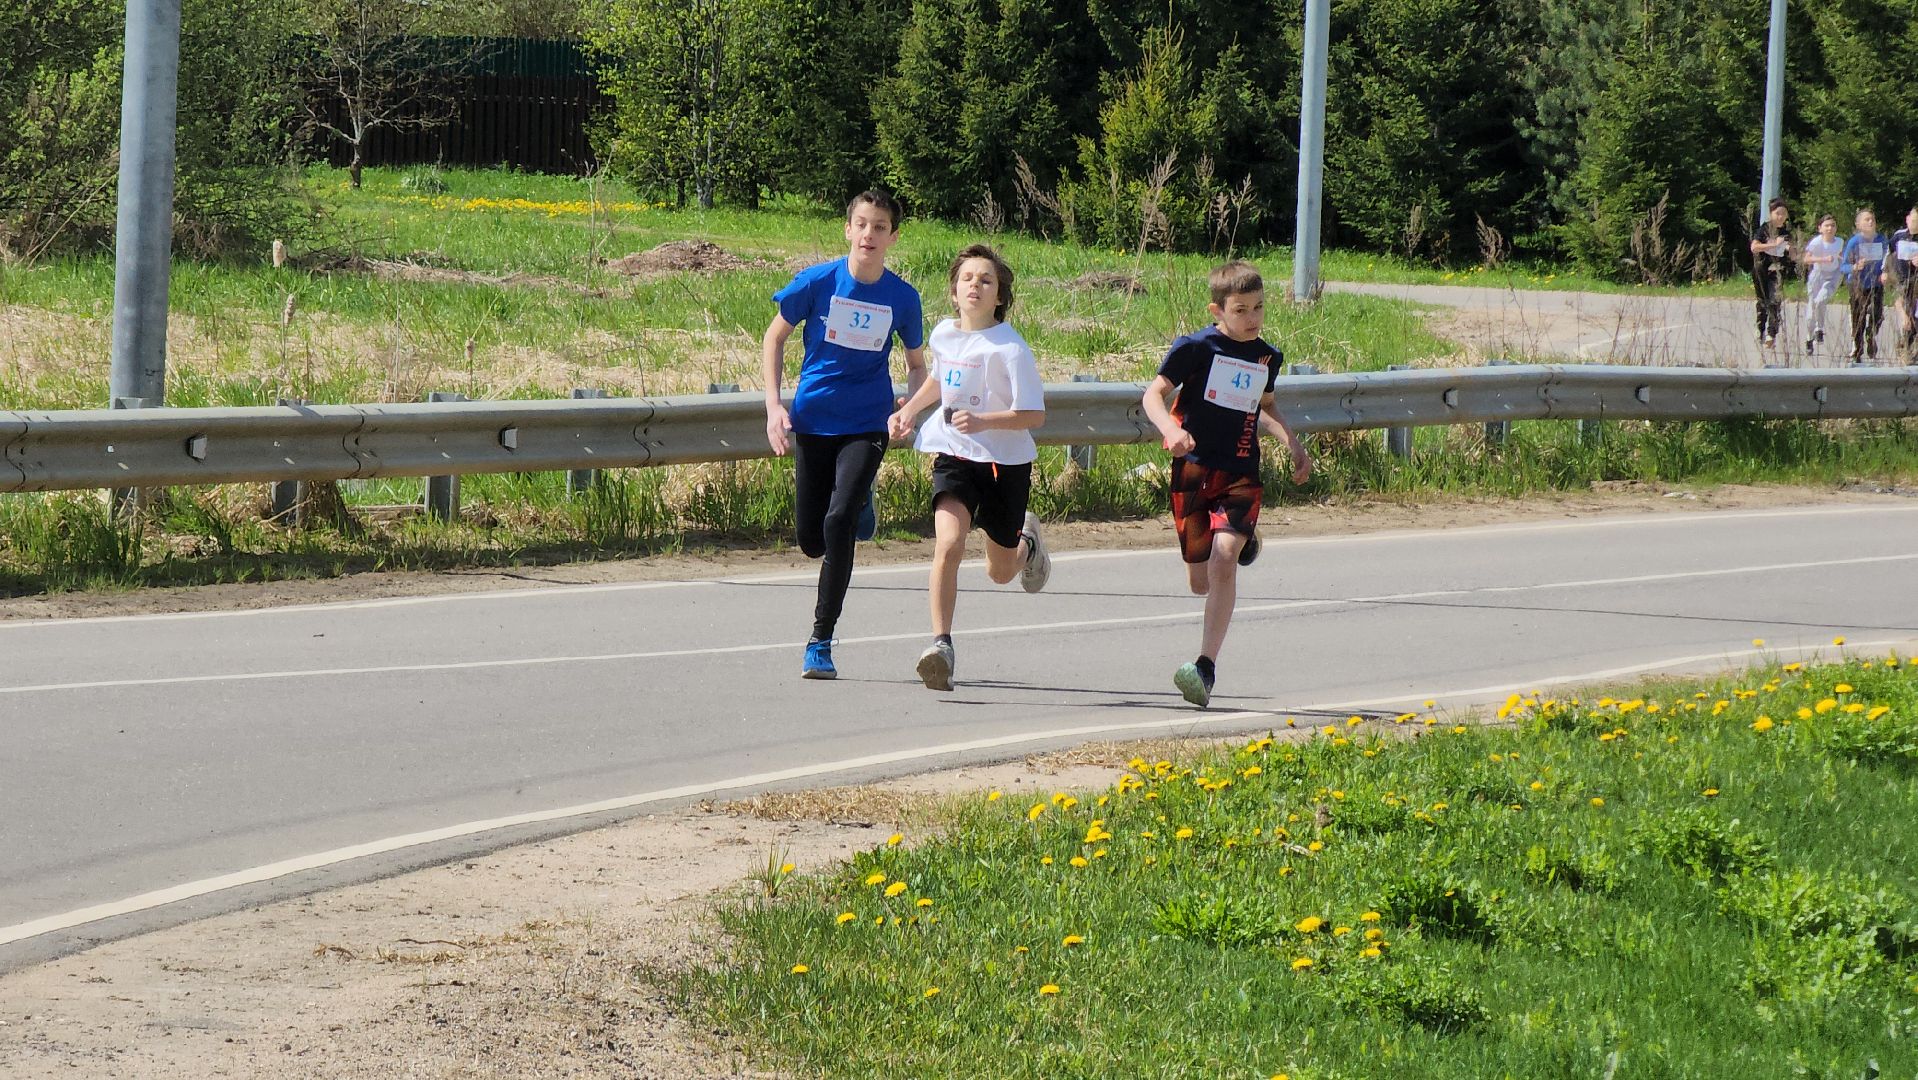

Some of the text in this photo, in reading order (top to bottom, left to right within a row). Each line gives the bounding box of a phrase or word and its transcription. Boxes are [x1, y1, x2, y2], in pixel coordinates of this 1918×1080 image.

[849, 311, 871, 329] 32
[944, 368, 961, 387] 42
[1231, 371, 1251, 389] 43
